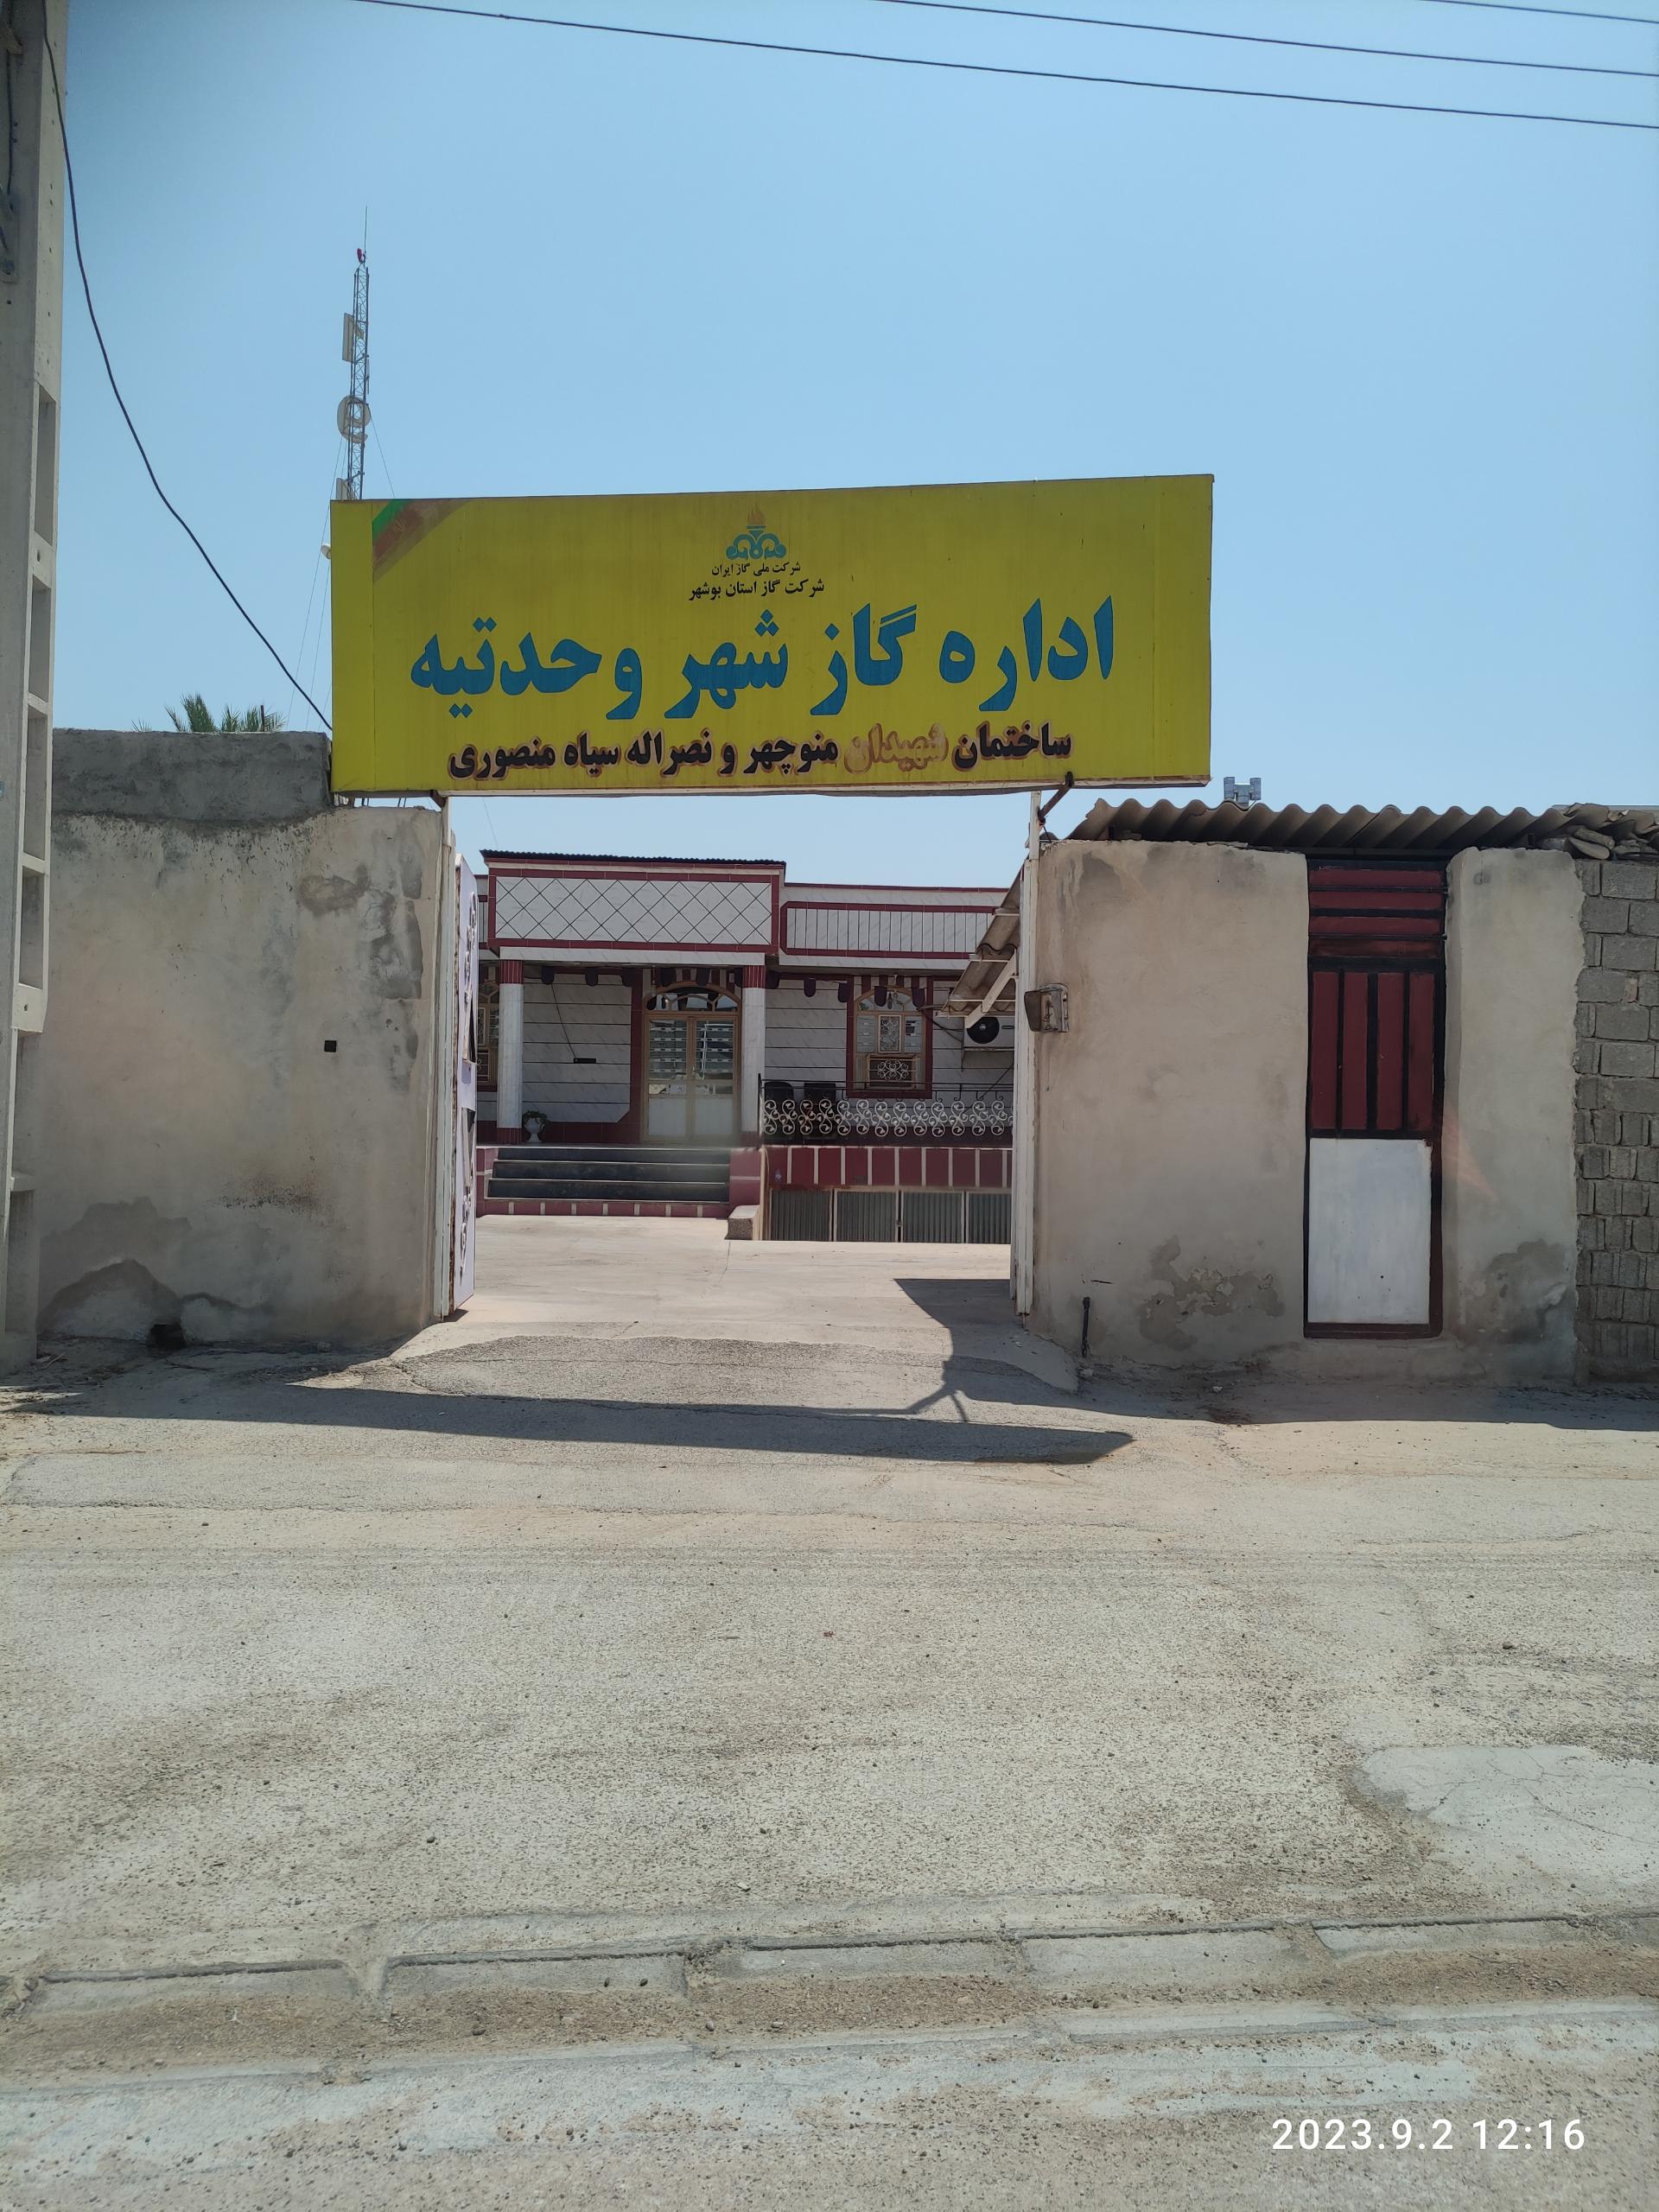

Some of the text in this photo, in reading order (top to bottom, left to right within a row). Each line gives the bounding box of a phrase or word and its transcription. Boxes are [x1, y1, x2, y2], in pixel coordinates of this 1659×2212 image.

[688, 578, 825, 601] شرکت گاز استان بوشهر
[711, 561, 801, 578] شرکت ملی گاز ایران
[664, 608, 789, 720] شهر
[809, 602, 918, 716] گاز
[938, 594, 1115, 713] اداره
[448, 737, 557, 779] منصوری
[563, 733, 620, 776] سیاه
[719, 743, 737, 776] و
[742, 732, 839, 776] منوچهر
[952, 721, 1073, 771] ساختمان
